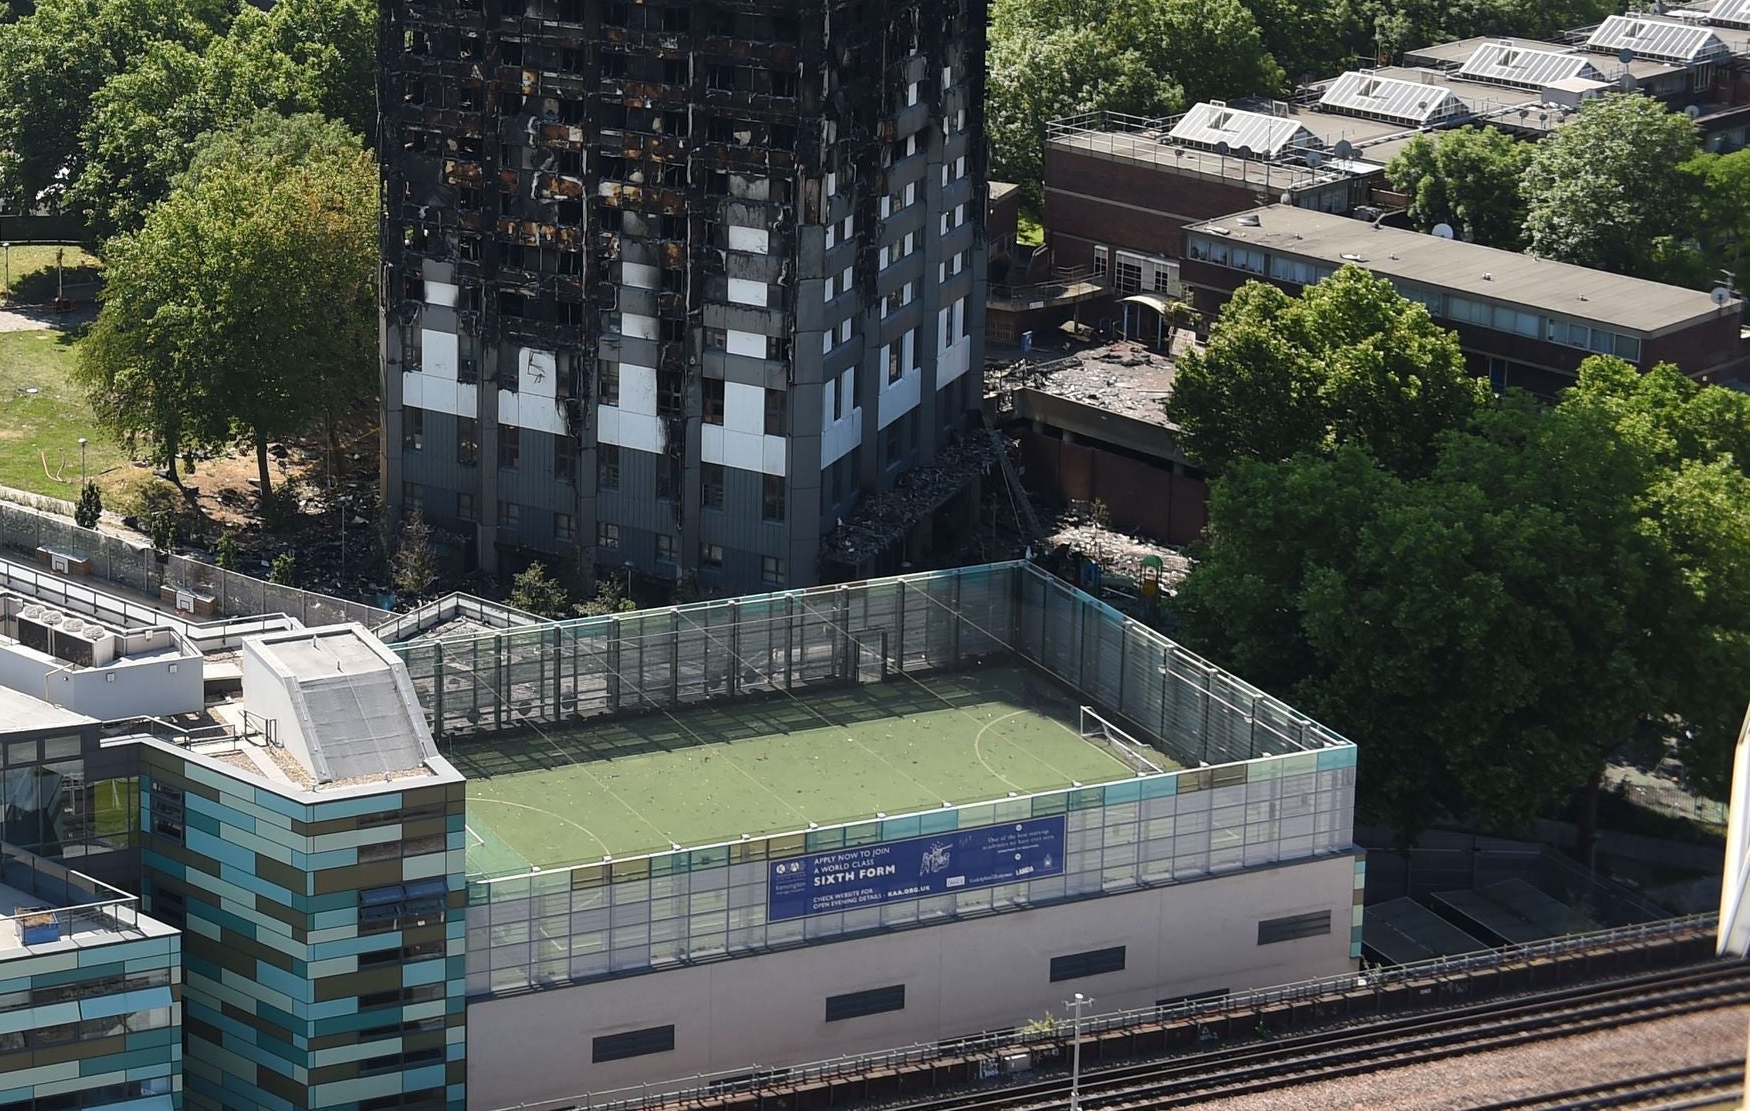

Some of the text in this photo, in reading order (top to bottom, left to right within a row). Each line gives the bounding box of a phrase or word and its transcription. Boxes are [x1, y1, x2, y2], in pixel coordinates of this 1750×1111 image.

[814, 848, 890, 865] APPLY NOW TO JOIN
[821, 863, 850, 872] WORLD
[852, 859, 874, 868] CLASS
[814, 872, 855, 886] SIXTH
[859, 864, 896, 879] FORM
[813, 892, 834, 903] CHECK
[834, 890, 860, 900] WEBSITE
[813, 901, 830, 910] OPEN
[831, 897, 858, 906] EVENING
[858, 893, 882, 903] DETAILS
[888, 885, 930, 897] KAA.ORG.UK
